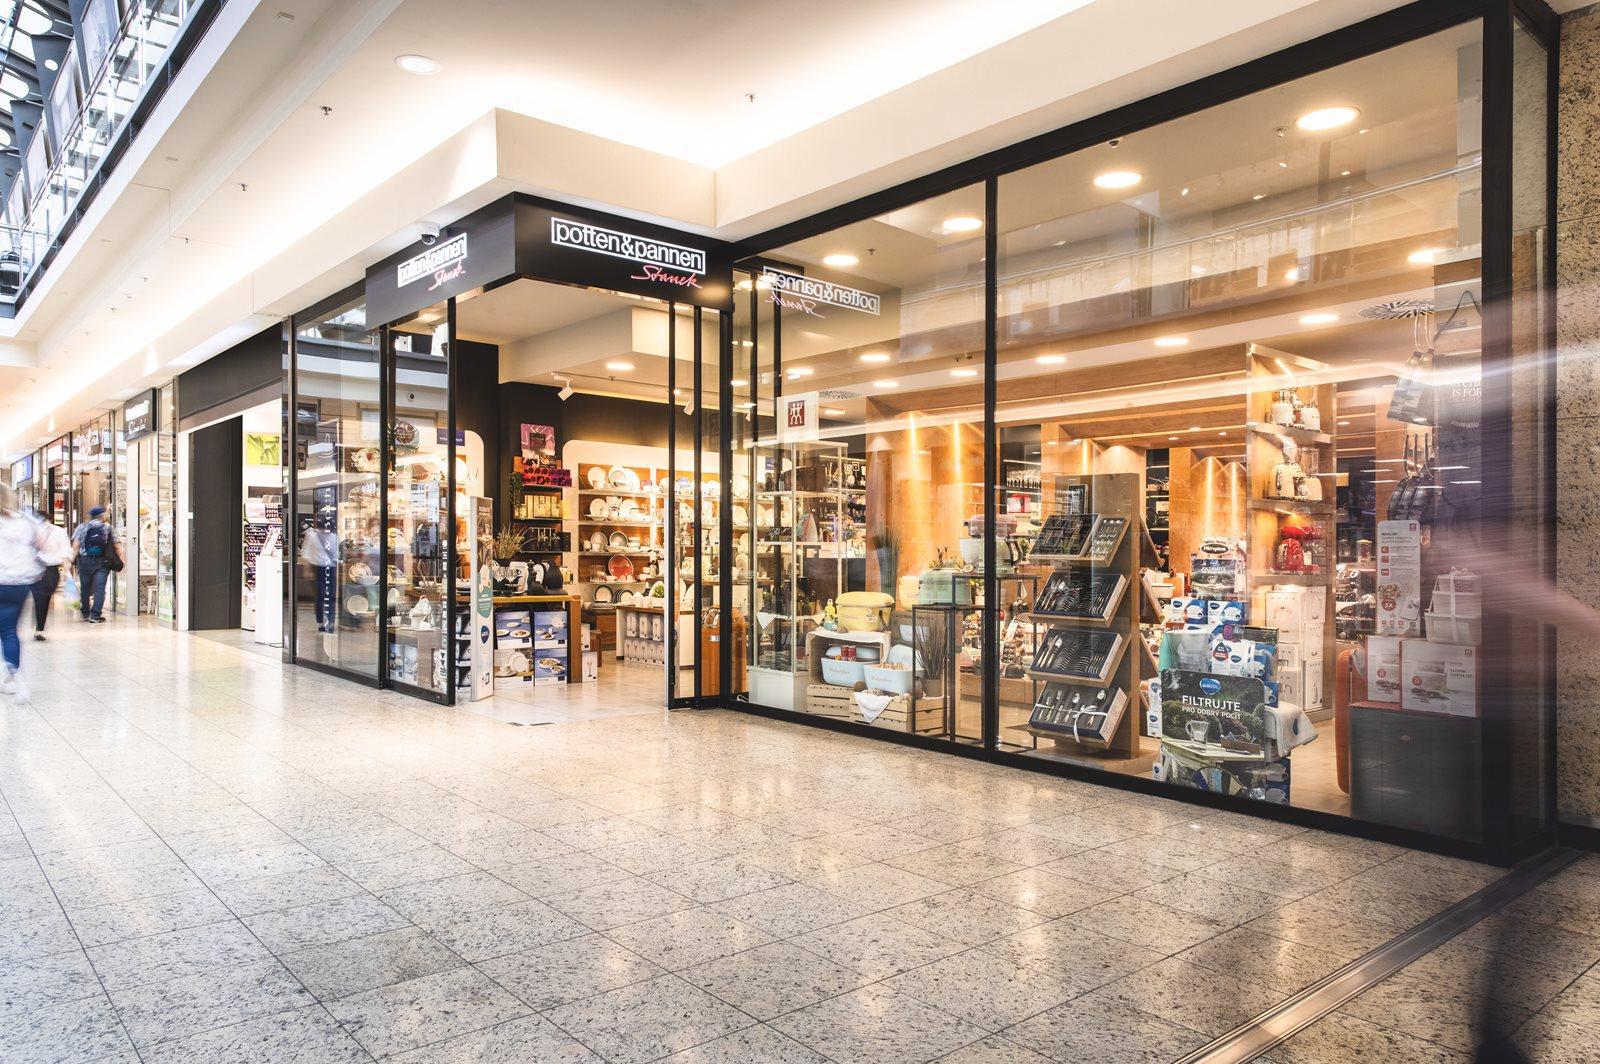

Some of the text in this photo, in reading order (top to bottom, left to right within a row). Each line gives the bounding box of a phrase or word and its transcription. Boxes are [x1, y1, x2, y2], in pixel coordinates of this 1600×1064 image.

[556, 221, 702, 270] potten&pannen
[631, 264, 703, 289] Stanek
[322, 559, 331, 628] Villeroy
[1182, 695, 1241, 712] FILTRUJTE
[1182, 706, 1195, 714] PRO
